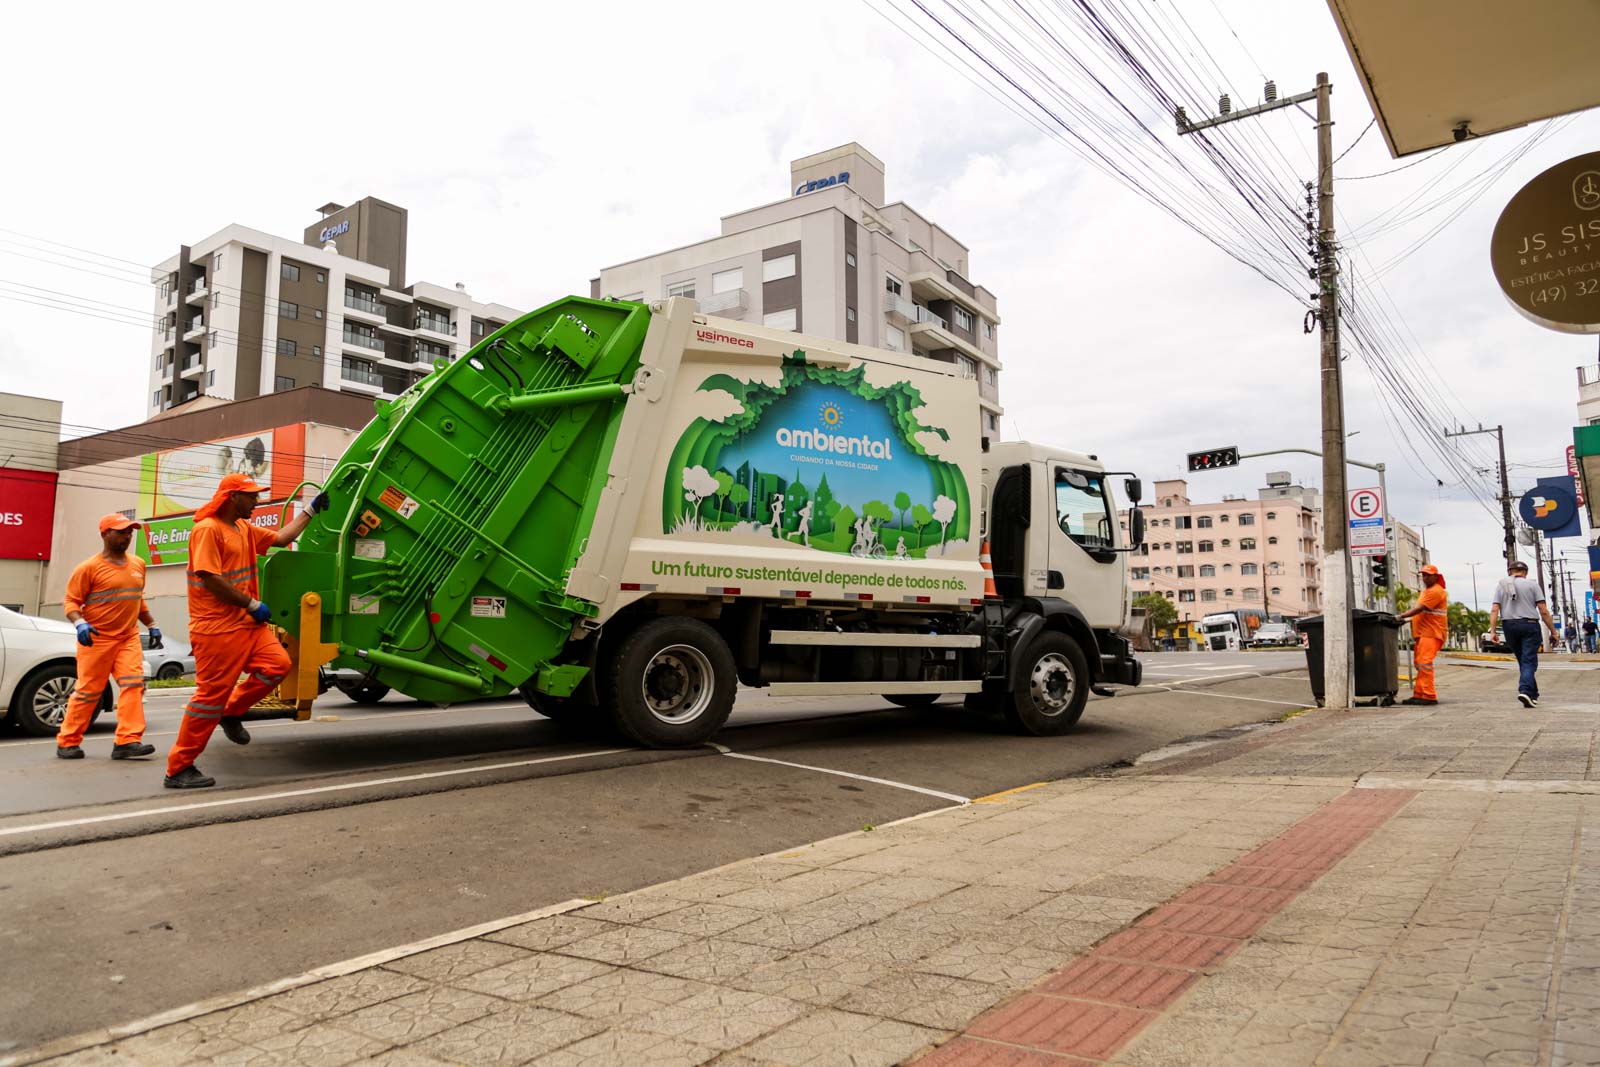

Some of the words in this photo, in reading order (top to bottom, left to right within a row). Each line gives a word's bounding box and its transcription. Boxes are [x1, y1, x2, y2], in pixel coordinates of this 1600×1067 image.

[319, 220, 350, 242] CEPAR
[1518, 233, 1547, 254] JS
[1561, 220, 1600, 244] SIS
[1520, 243, 1592, 265] BEAUTY
[1511, 268, 1565, 288] ESTÉTICA
[1530, 285, 1567, 307] (49)
[1575, 278, 1600, 296] 32
[697, 330, 754, 349] usimeca
[775, 427, 893, 461] ambiental
[790, 454, 824, 465] CUIDANDO
[825, 458, 834, 466] DA
[1360, 496, 1371, 512] E
[148, 529, 169, 545] Tele
[651, 560, 681, 577] Um
[684, 561, 733, 579] futuro
[735, 566, 823, 584] sustentável
[825, 570, 885, 589] depende
[886, 574, 904, 588] de
[905, 575, 940, 590] todos
[942, 576, 967, 591] nós.
